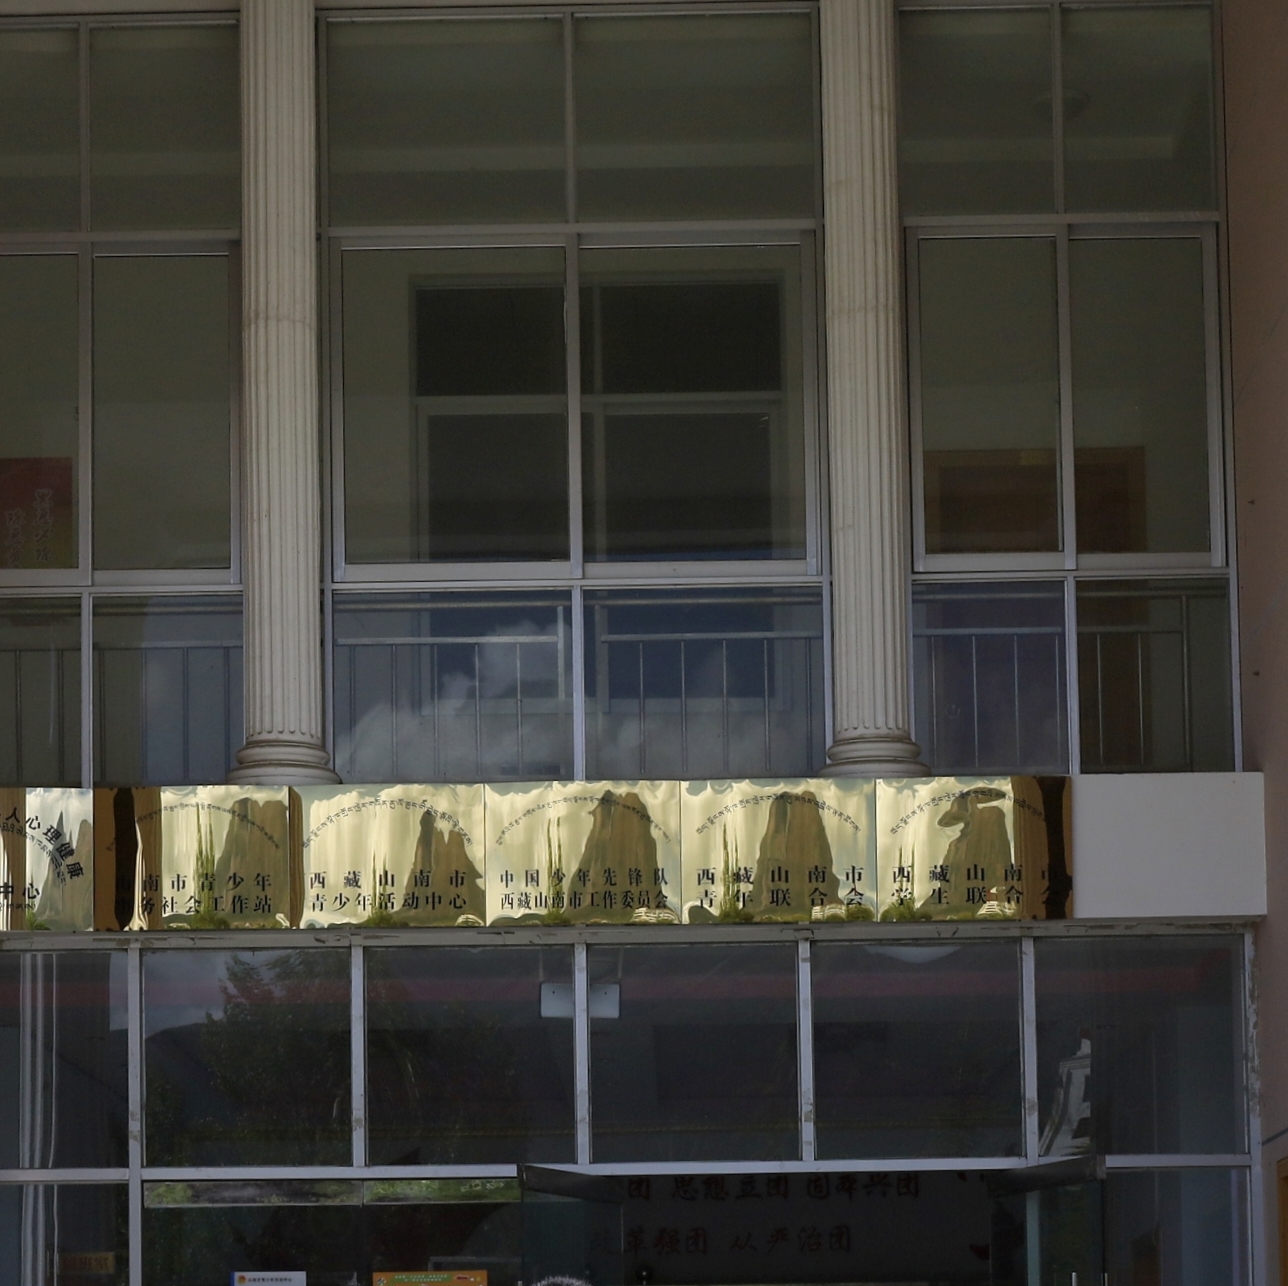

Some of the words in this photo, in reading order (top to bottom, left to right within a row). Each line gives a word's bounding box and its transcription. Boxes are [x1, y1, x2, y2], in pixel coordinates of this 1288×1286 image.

[310, 869, 467, 890] 西藏山南市
[500, 868, 669, 889] 中国少年先锋队
[696, 865, 865, 886] 西藏山南市
[310, 891, 467, 912] 青少年活动中心
[500, 890, 669, 910] 西藏山南市工作委员会
[697, 887, 865, 908] 青年联合会
